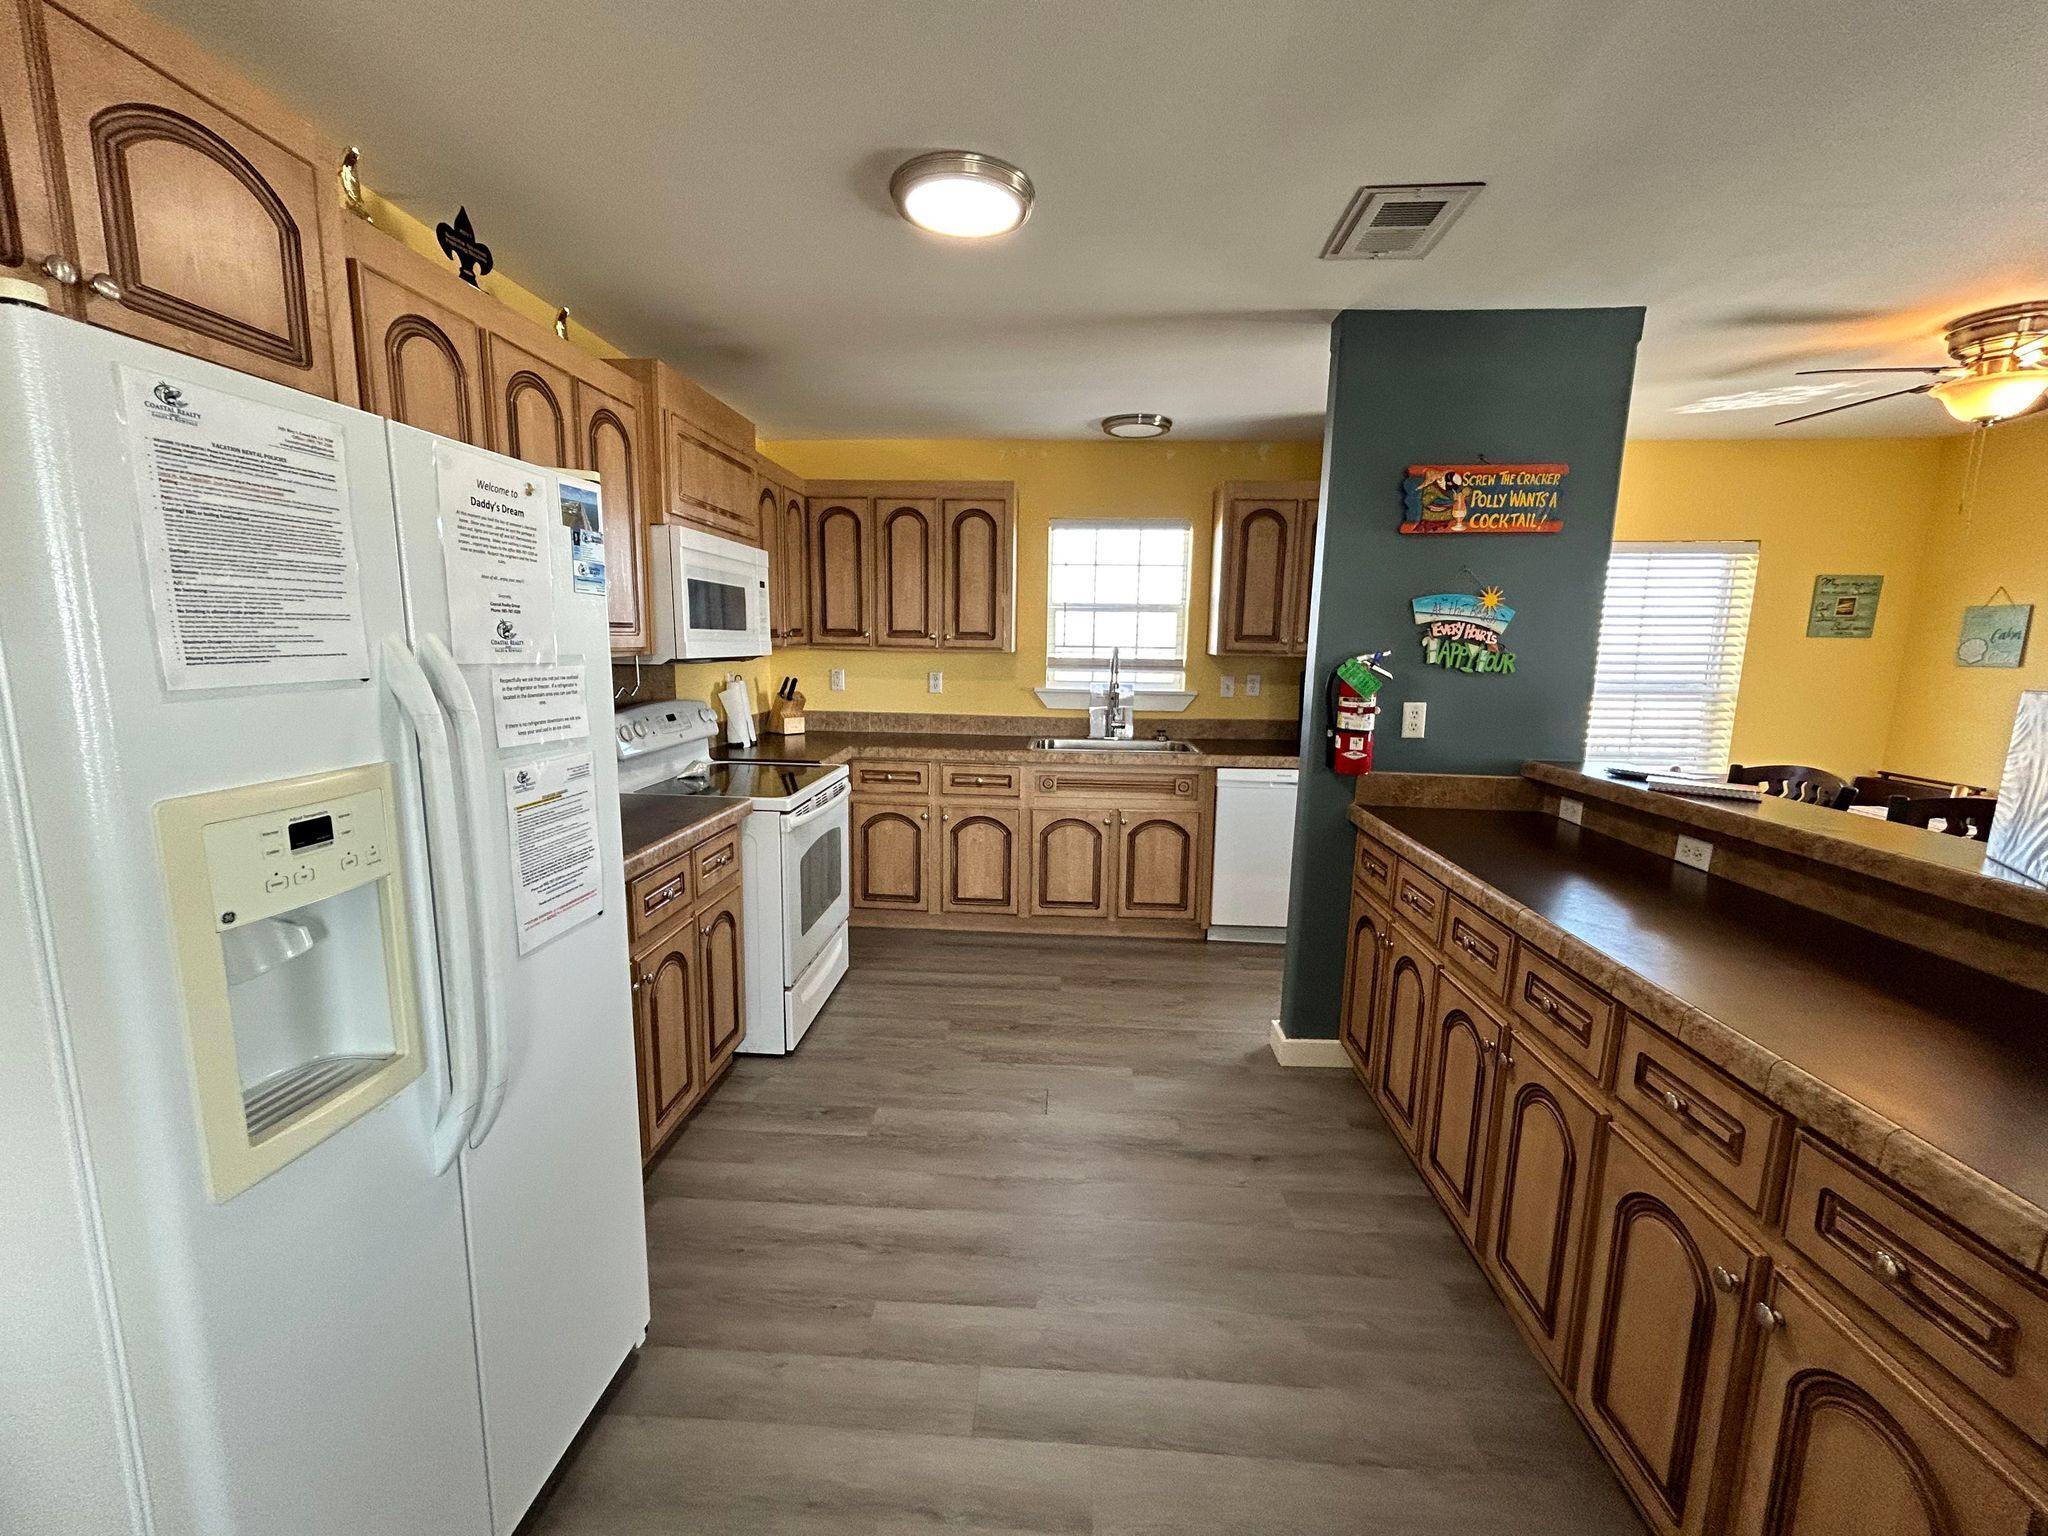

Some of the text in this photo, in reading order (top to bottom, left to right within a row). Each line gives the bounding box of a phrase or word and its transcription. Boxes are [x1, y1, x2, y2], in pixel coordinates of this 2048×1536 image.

[144, 400, 201, 420] COASTAL REALTY
[211, 442, 288, 464] VACATION RENTAL POLICIES
[1462, 470, 1561, 487] SCREW THE CRACKER
[476, 479, 518, 499] Welcome to
[1470, 490, 1558, 508] POLLY WANTS A
[470, 496, 525, 518] Daddy's Dream
[1424, 637, 1516, 673] HAPPY HOUR
